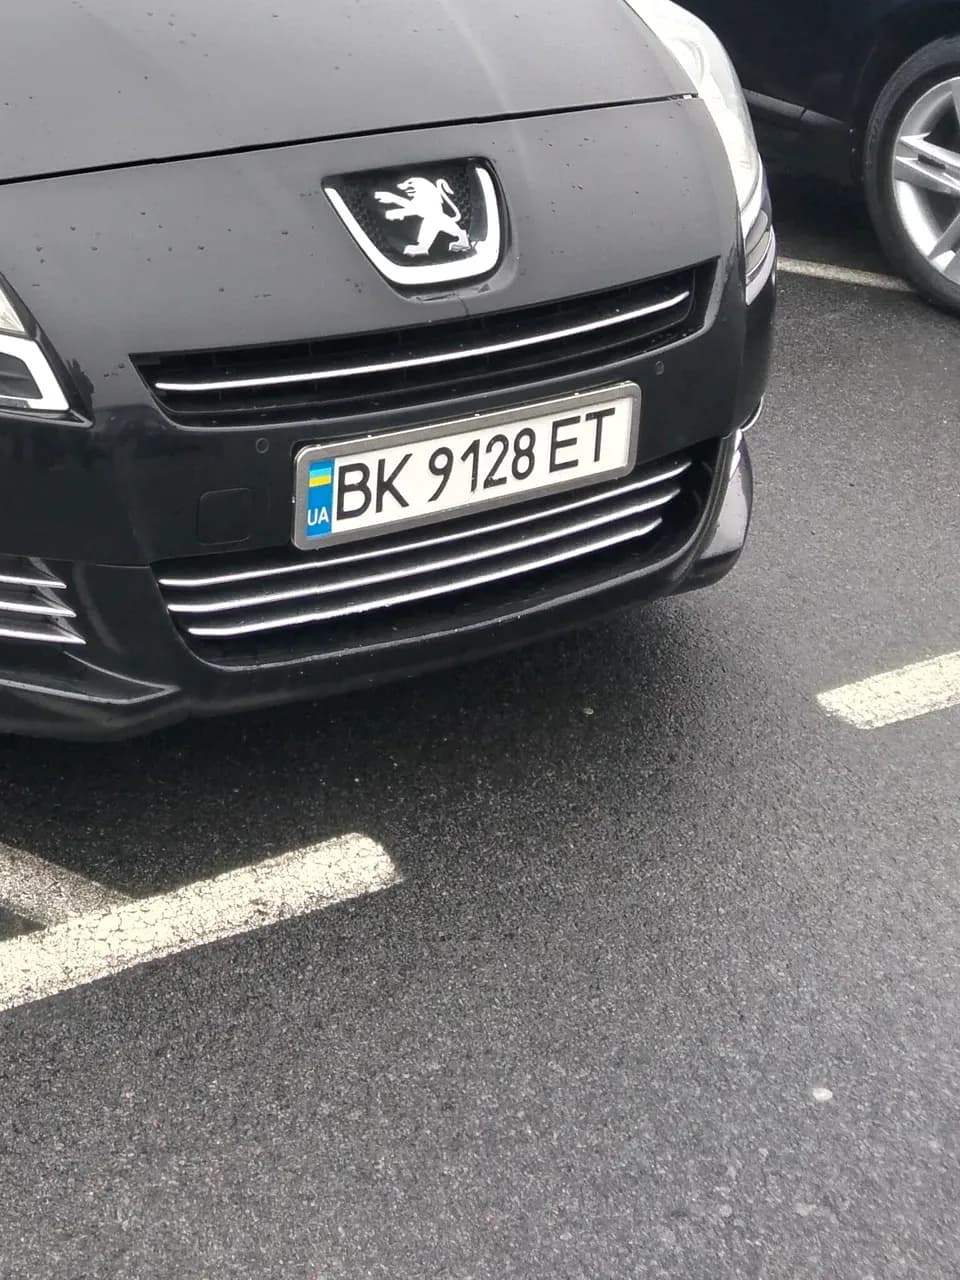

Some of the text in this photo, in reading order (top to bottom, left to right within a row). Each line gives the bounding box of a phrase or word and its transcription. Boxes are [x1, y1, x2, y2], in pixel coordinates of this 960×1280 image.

[428, 427, 536, 502] 9128
[549, 407, 616, 473] ET
[307, 507, 329, 526] UA
